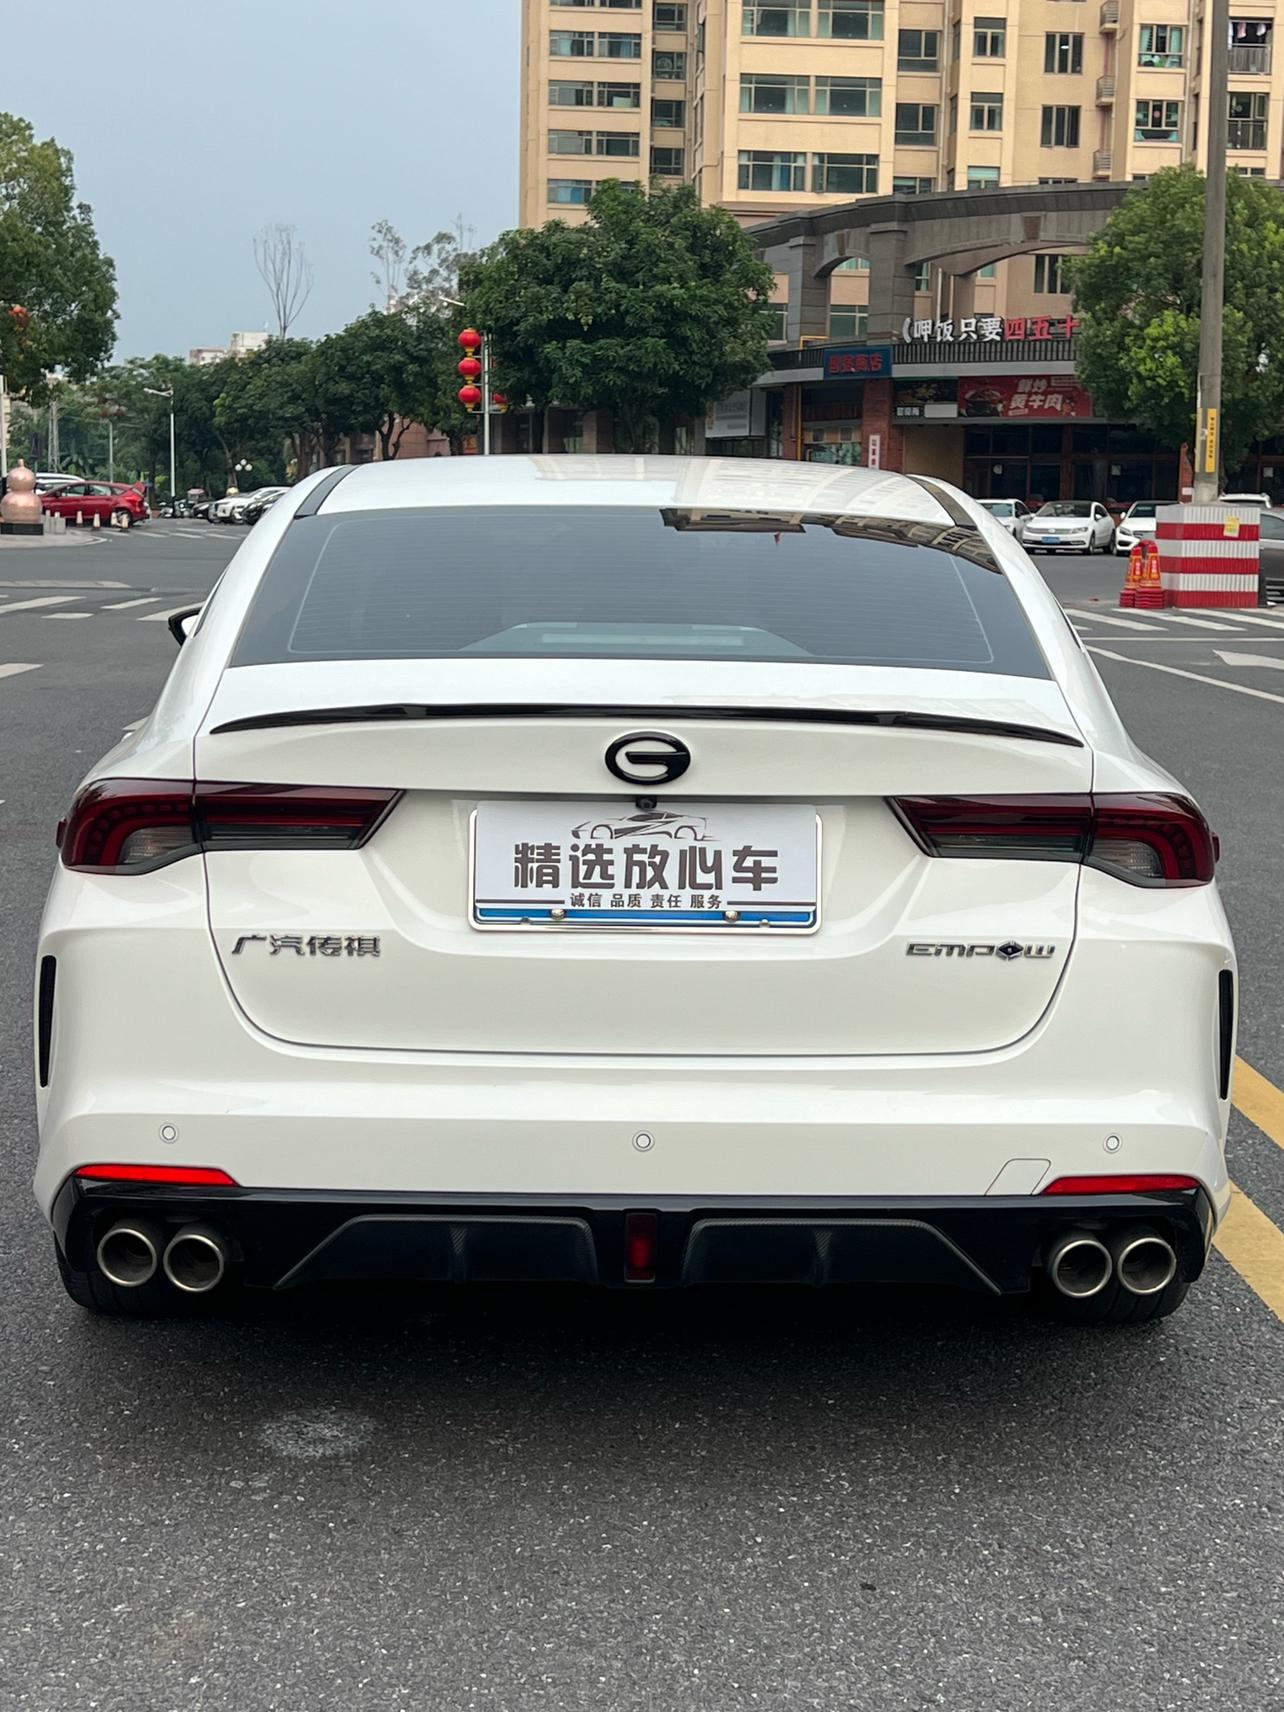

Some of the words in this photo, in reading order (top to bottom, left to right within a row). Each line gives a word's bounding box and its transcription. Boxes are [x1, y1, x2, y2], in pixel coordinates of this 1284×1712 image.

[513, 842, 779, 892] 精选放心车
[569, 892, 602, 908] 诚信
[610, 893, 642, 908] 品质
[650, 893, 682, 909] 责任
[690, 894, 722, 910] 服务
[231, 934, 381, 957] 广汽传祺
